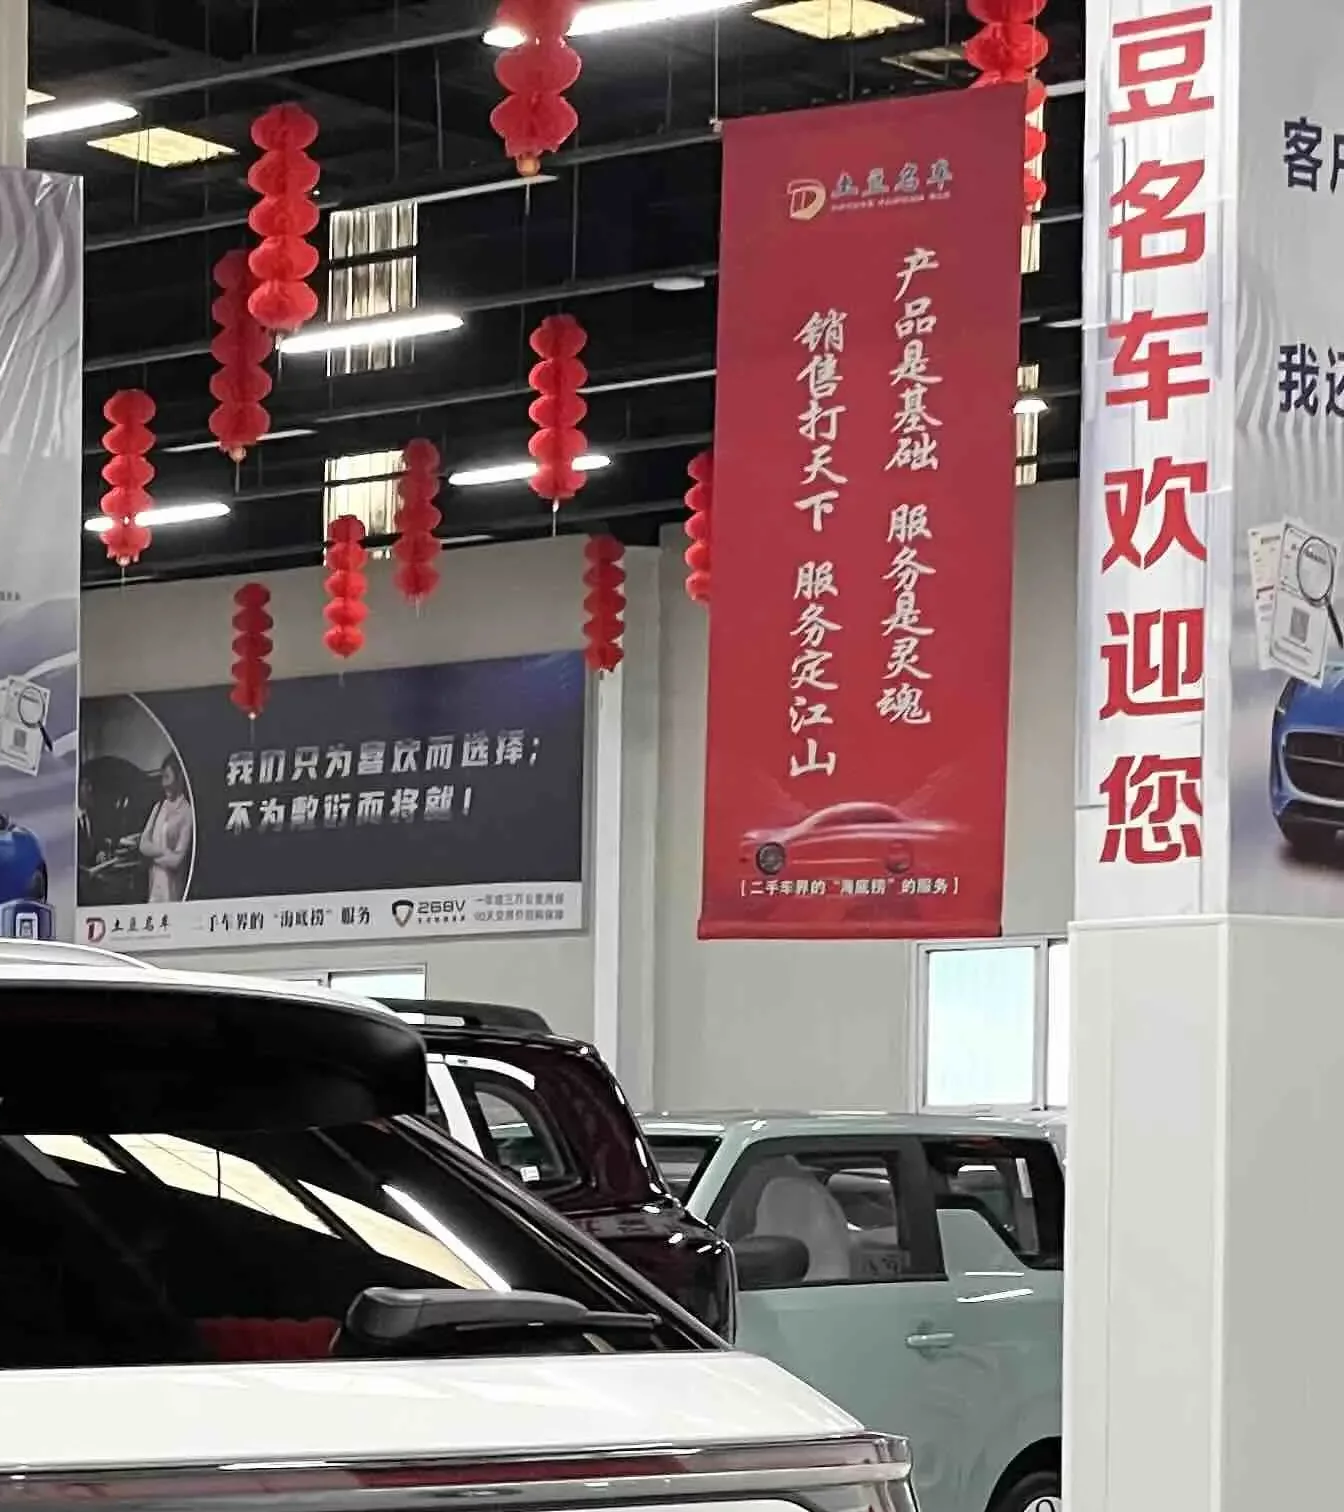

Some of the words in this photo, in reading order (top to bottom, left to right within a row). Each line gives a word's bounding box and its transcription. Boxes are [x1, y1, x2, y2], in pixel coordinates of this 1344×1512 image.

[793, 308, 849, 533] 销售打天下
[884, 247, 944, 472] 产品是基础
[1099, 5, 1215, 865] 豆名车欢迎您
[789, 560, 843, 777] 服务定江山
[875, 503, 937, 726] 服务是灵魂
